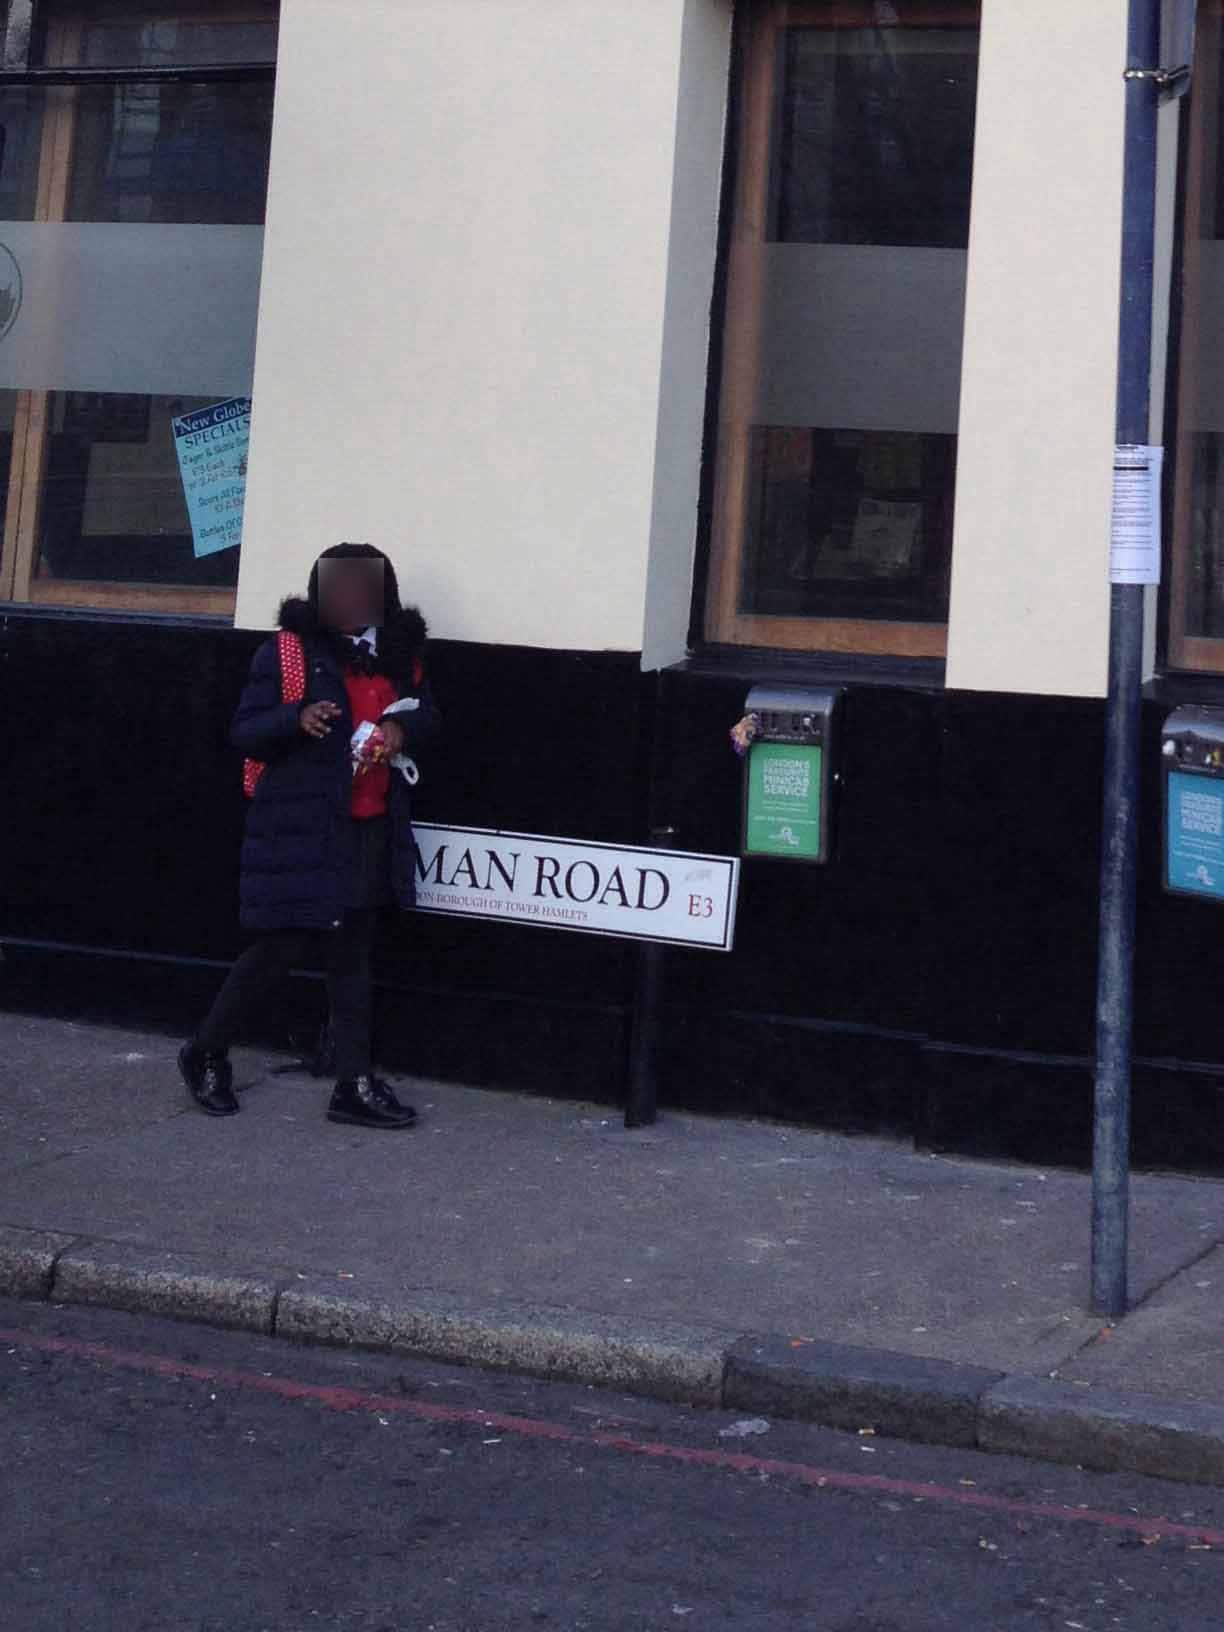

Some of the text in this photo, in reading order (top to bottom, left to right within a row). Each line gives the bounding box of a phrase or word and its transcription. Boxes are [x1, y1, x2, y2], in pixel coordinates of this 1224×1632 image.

[175, 416, 210, 435] New
[532, 855, 670, 911] ROAD
[437, 894, 488, 909] BOROUGH
[489, 899, 504, 911] OF
[505, 901, 540, 915] TOWER
[541, 906, 589, 922] HAMLETS
[688, 894, 713, 918] E3
